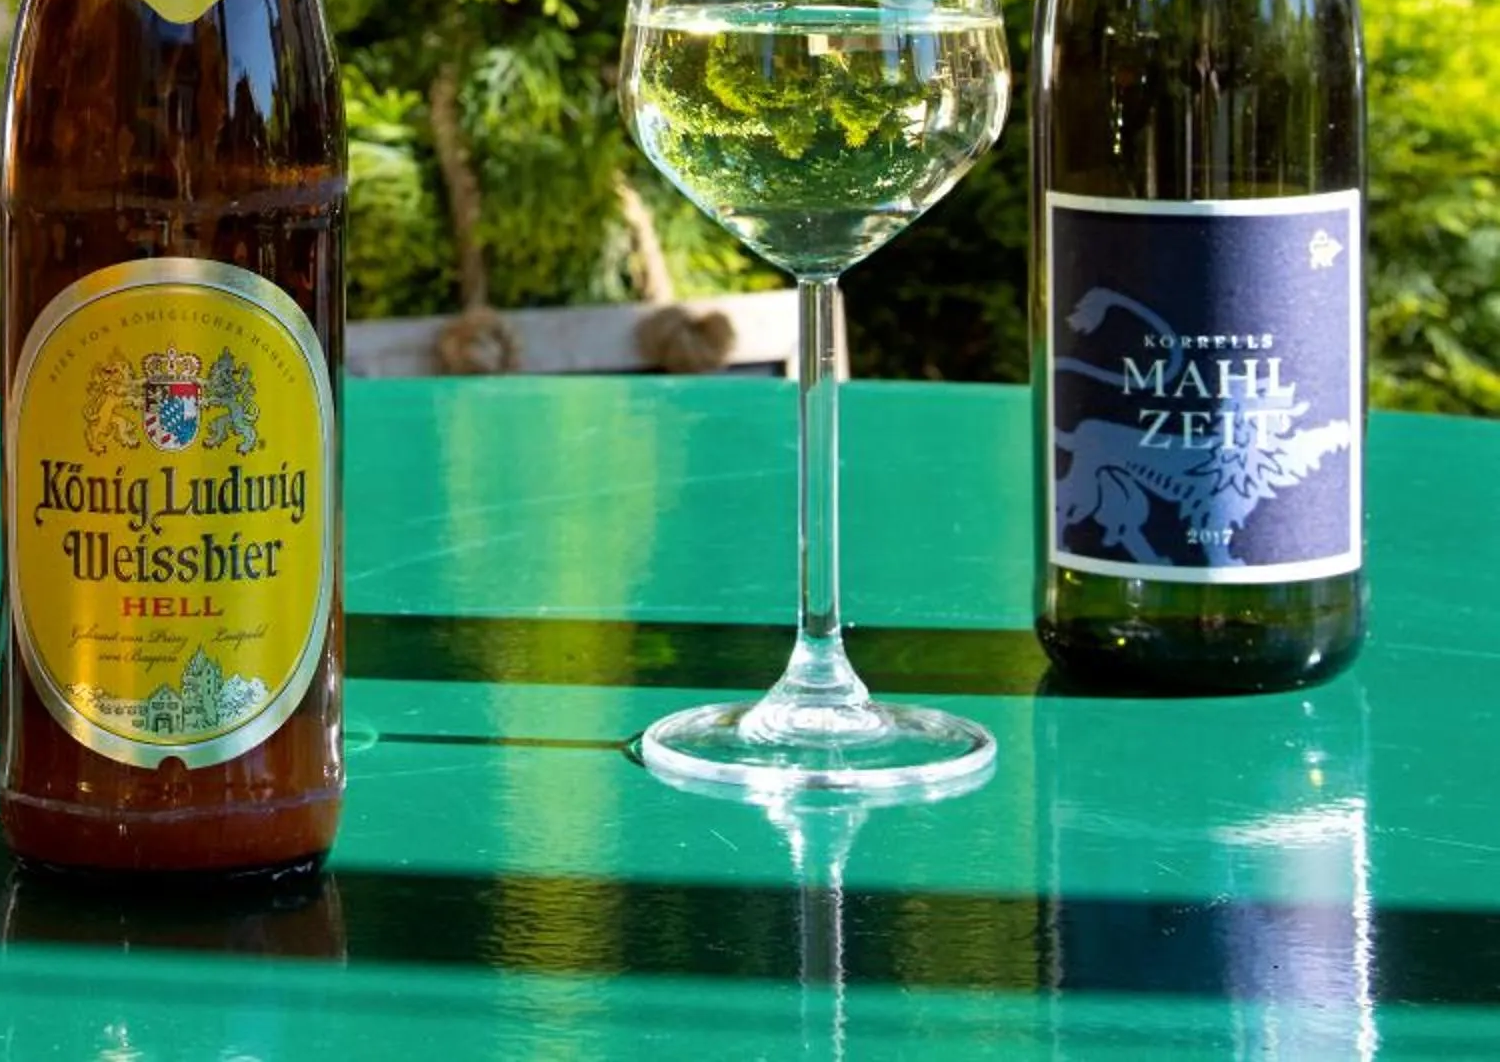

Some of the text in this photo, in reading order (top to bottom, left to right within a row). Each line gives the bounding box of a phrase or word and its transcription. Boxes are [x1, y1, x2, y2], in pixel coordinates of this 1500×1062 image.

[1121, 356, 1297, 399] MAHL
[1138, 408, 1282, 451] ZEIT
[34, 459, 307, 535] König Ludwig
[63, 529, 283, 584] Weissbier
[1185, 528, 1234, 546] 2017
[122, 596, 225, 618] HELL
